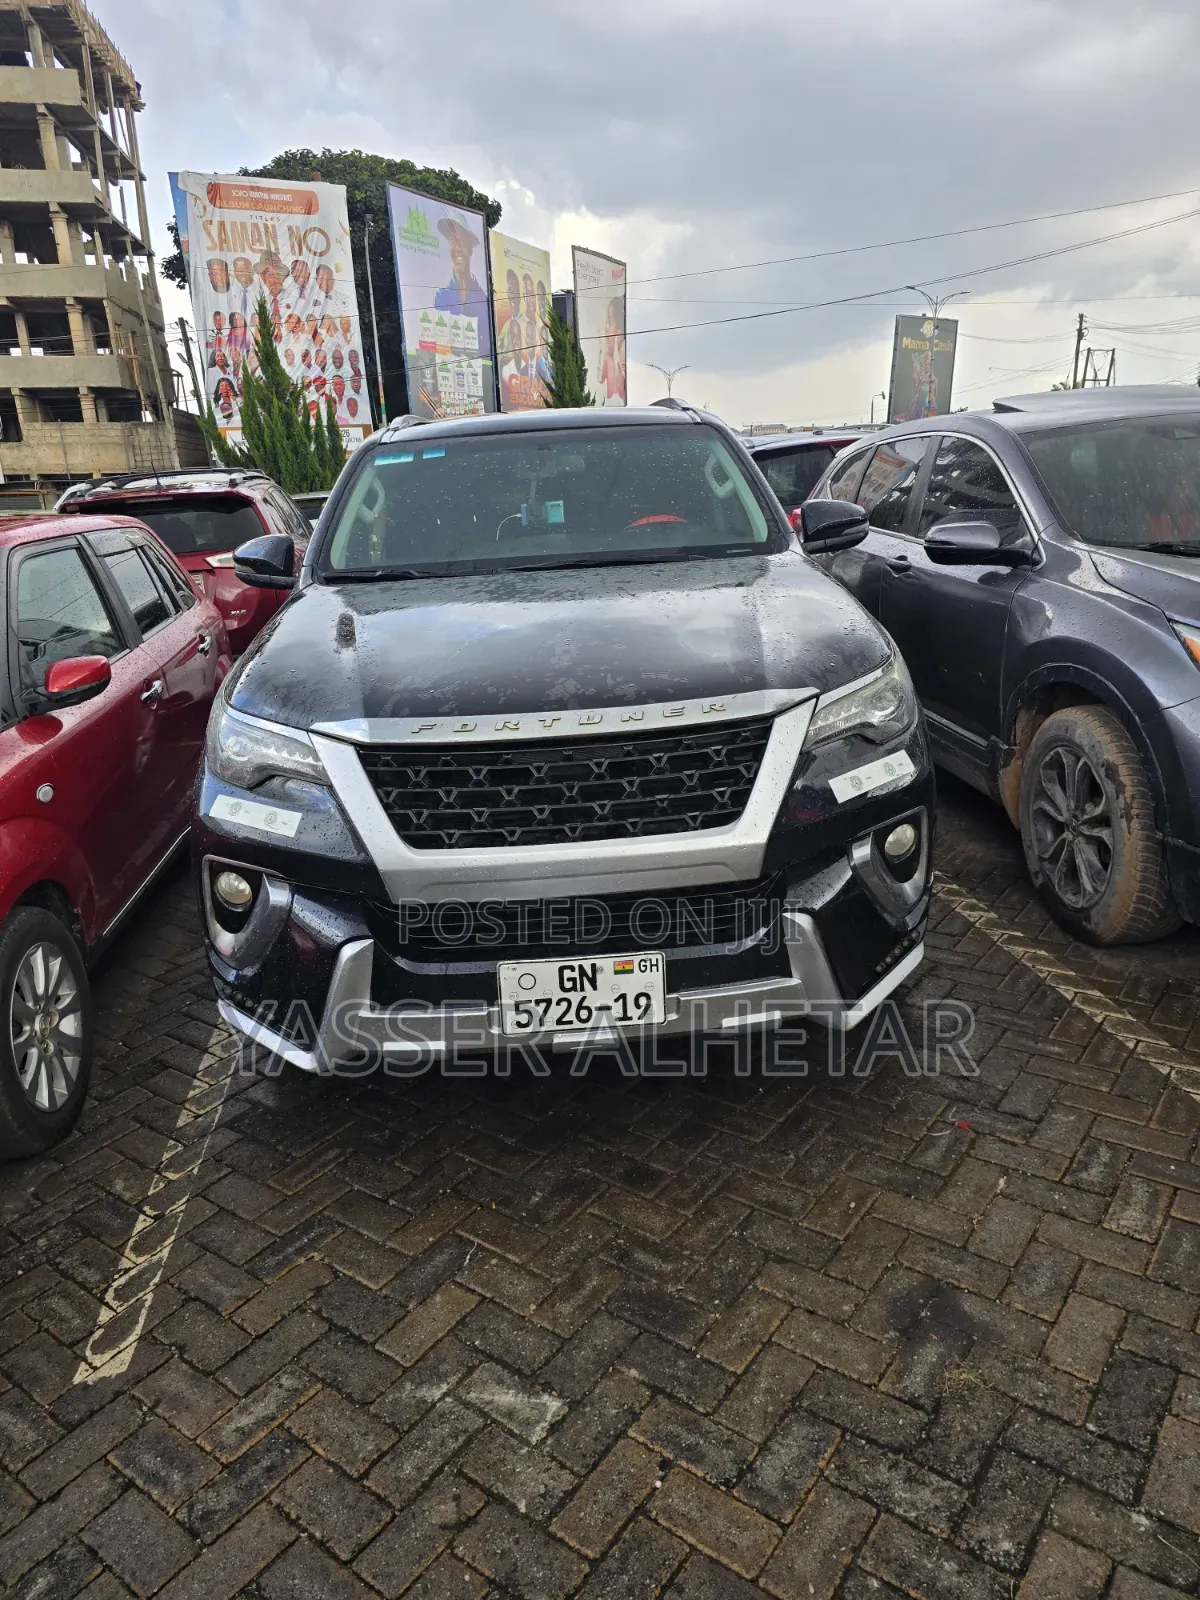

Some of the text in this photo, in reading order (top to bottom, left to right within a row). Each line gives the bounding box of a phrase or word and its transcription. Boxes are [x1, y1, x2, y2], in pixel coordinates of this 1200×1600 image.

[216, 199, 305, 214] ALBUM LAUNCHING
[249, 214, 281, 222] TITLED
[201, 219, 331, 257] SAMAN NO
[576, 259, 591, 272] Fresh
[902, 336, 953, 352] Mama Cash
[410, 701, 727, 734] FORTUNER
[558, 963, 598, 993] GN
[638, 957, 659, 973] GH
[514, 992, 652, 1029] 5726-19
